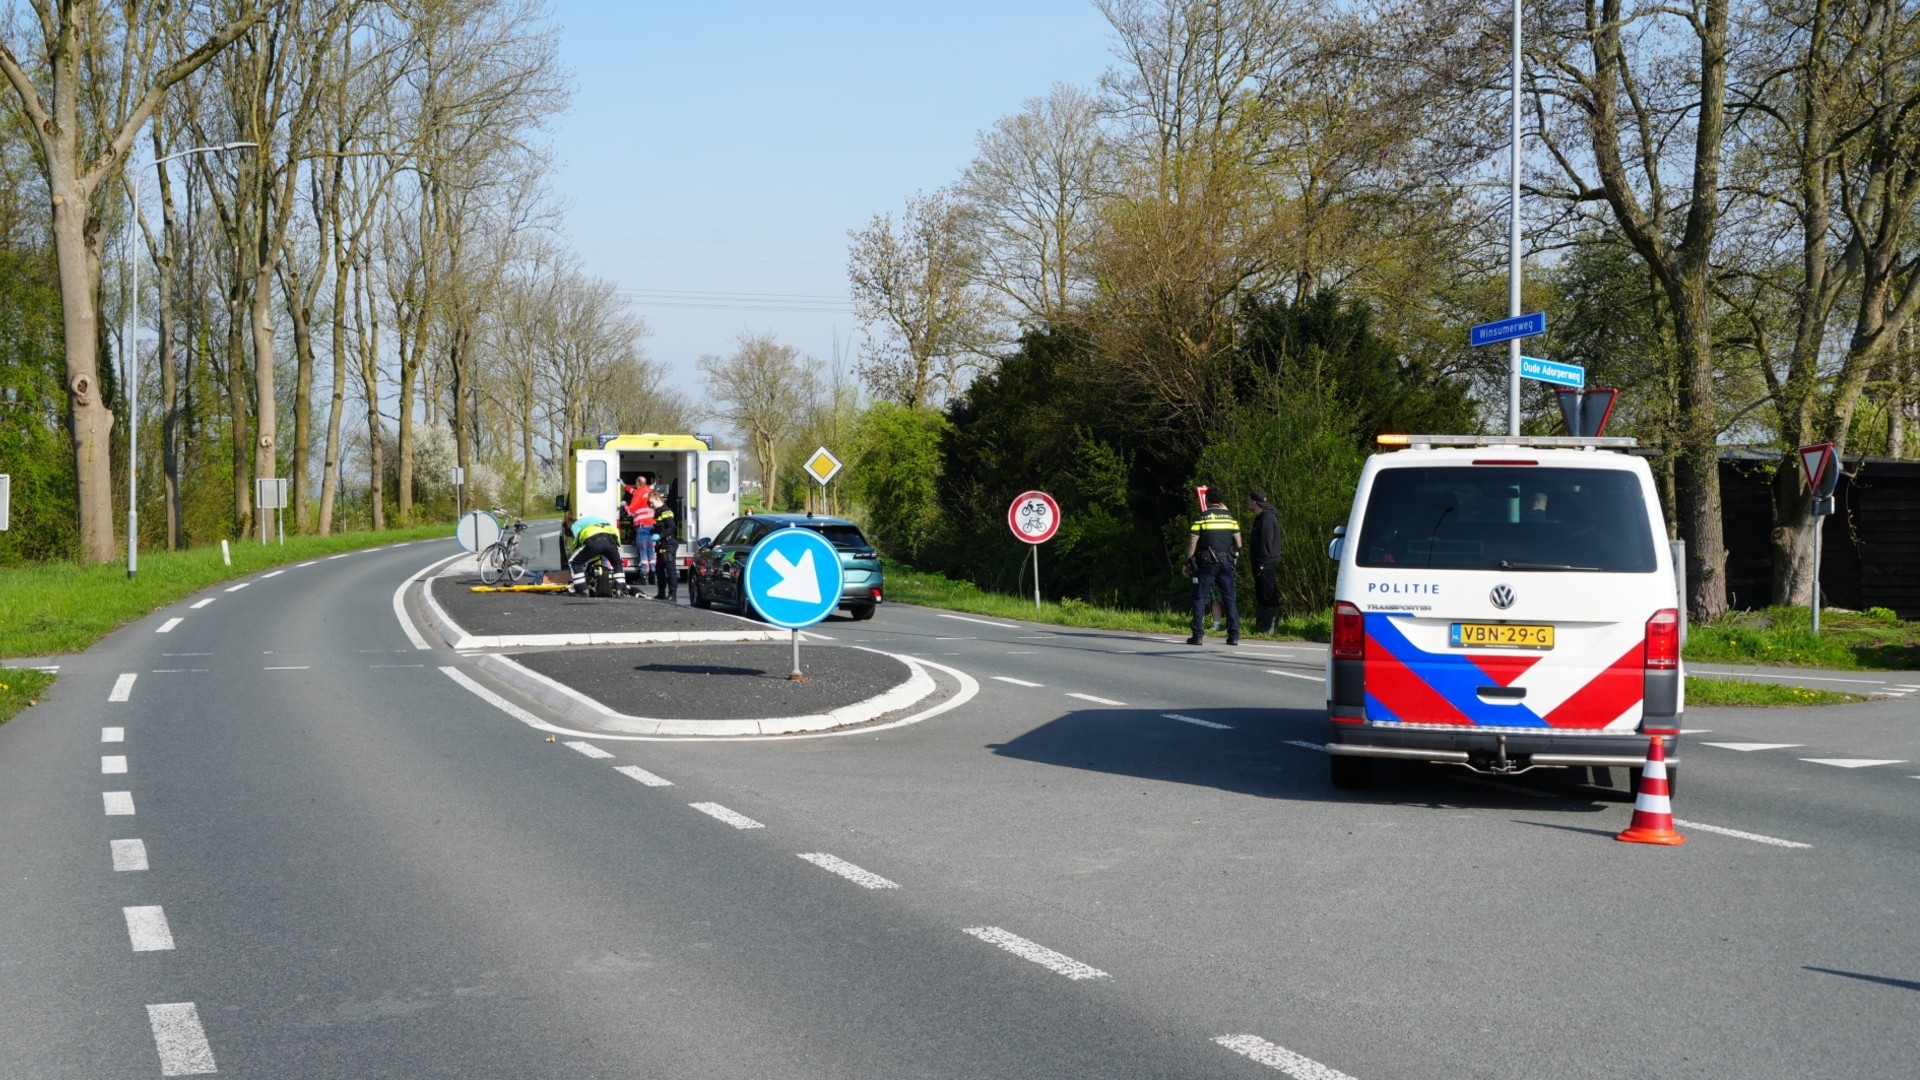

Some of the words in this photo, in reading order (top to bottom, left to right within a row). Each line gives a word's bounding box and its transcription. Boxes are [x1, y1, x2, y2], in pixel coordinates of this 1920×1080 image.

[1480, 321, 1533, 339] Winsumerweg
[1523, 361, 1540, 374] Oude
[1542, 365, 1580, 383] Adorperweg
[1368, 582, 1440, 594] POLITIE
[1464, 627, 1547, 643] VBN-29-G
